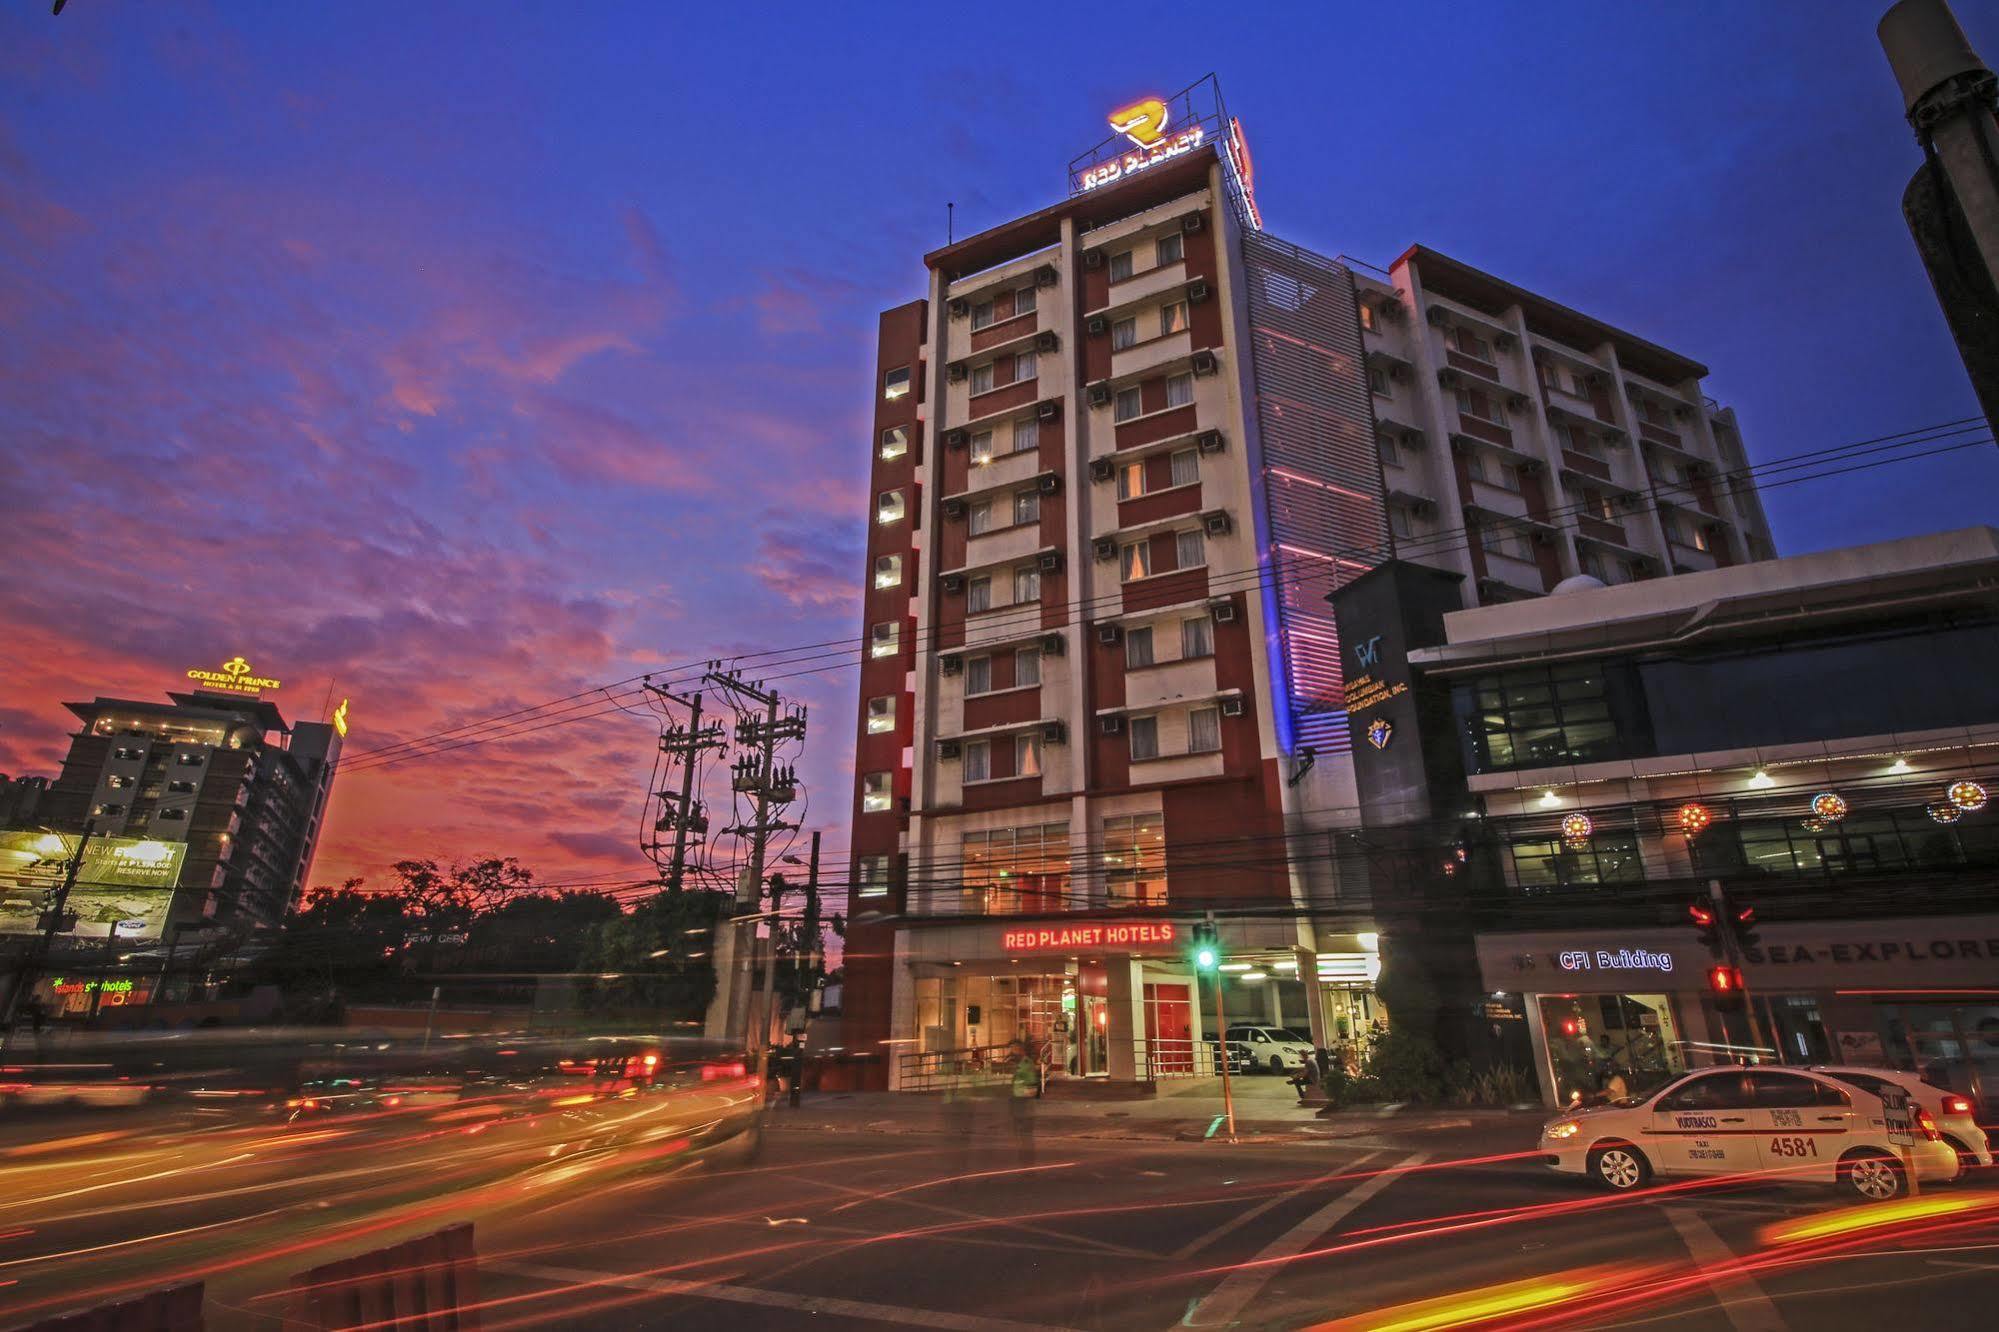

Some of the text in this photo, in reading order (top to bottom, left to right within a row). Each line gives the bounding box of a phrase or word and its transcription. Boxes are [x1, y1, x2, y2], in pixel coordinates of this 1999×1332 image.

[1082, 126, 1204, 190] RED PLANET
[187, 670, 236, 683] GOLDEN
[203, 681, 227, 689] HOTEL
[83, 844, 114, 856] NEW
[117, 867, 170, 877] RESERVE NOW
[1005, 924, 1173, 948] RED PLANET HOTELS
[1559, 949, 1673, 972] CFI Building
[103, 979, 133, 993] hotels
[1883, 1094, 1908, 1110] SLOW
[1886, 1118, 1912, 1137] DOWN
[1695, 1140, 1710, 1148] TAXI
[1770, 1137, 1818, 1157] 4581
